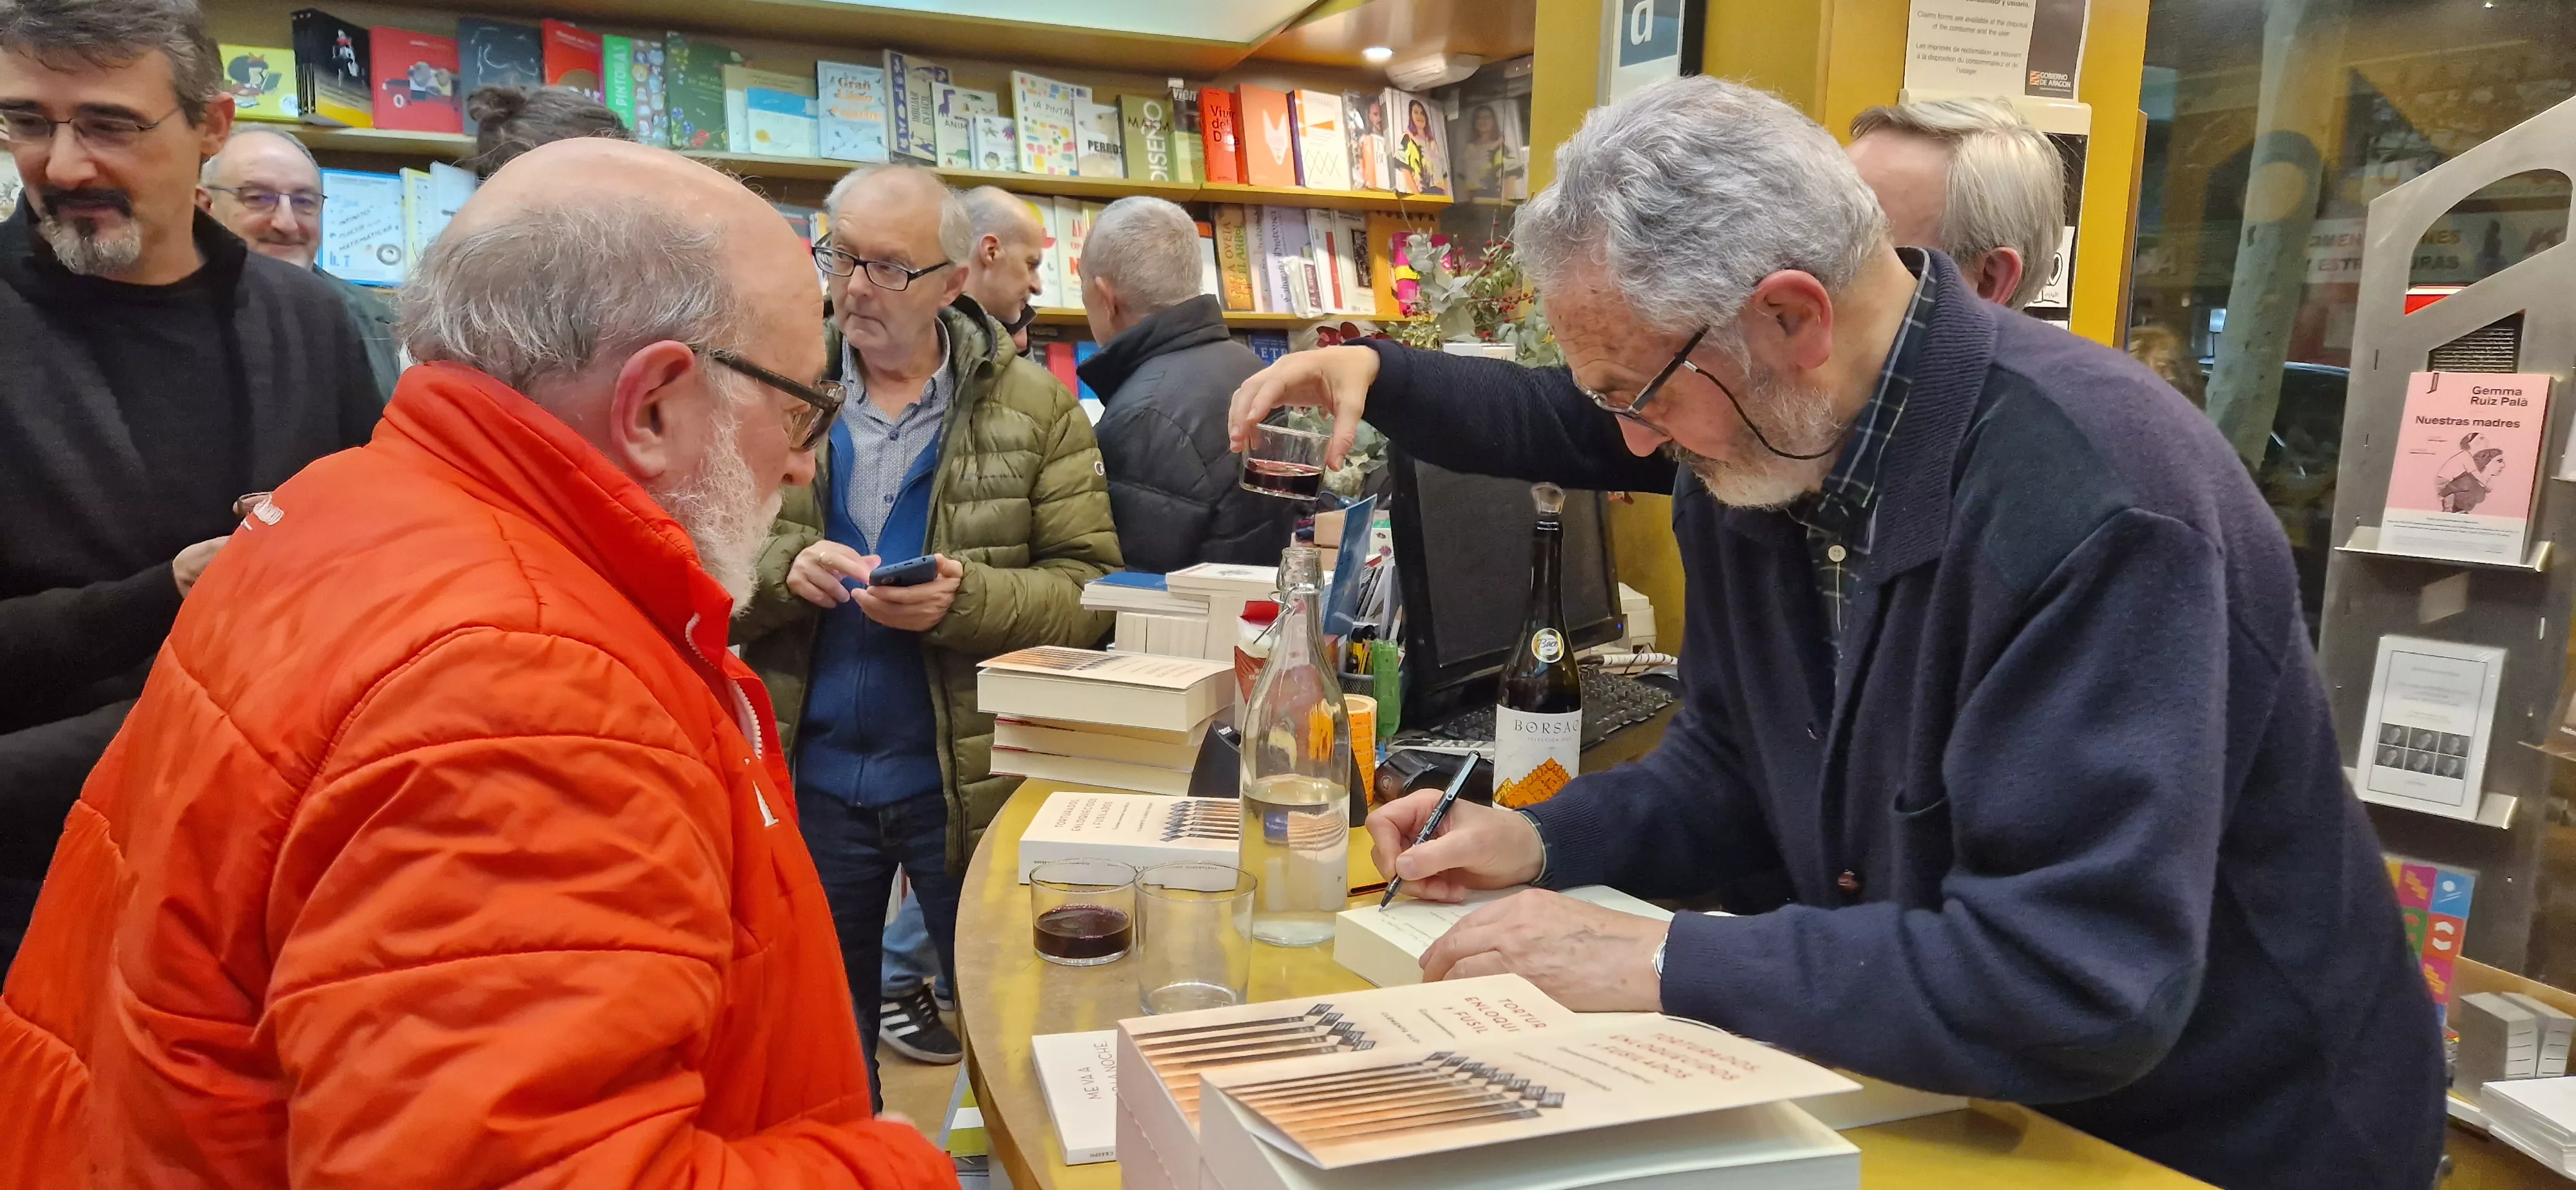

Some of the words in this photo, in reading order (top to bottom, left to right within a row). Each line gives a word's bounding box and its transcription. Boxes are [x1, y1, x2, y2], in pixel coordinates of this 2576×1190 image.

[2040, 72, 2069, 81] GOBIERNO
[2472, 386, 2523, 396] Gemma
[2470, 396, 2497, 406] Ruiz
[2415, 415, 2469, 426] Nuestras
[2472, 418, 2521, 428] madres
[1498, 997, 1548, 1029] TORTUR
[1453, 1011, 1489, 1034] FUSIL
[1080, 1073, 1095, 1085] VA
[1084, 1086, 1102, 1100] ME
